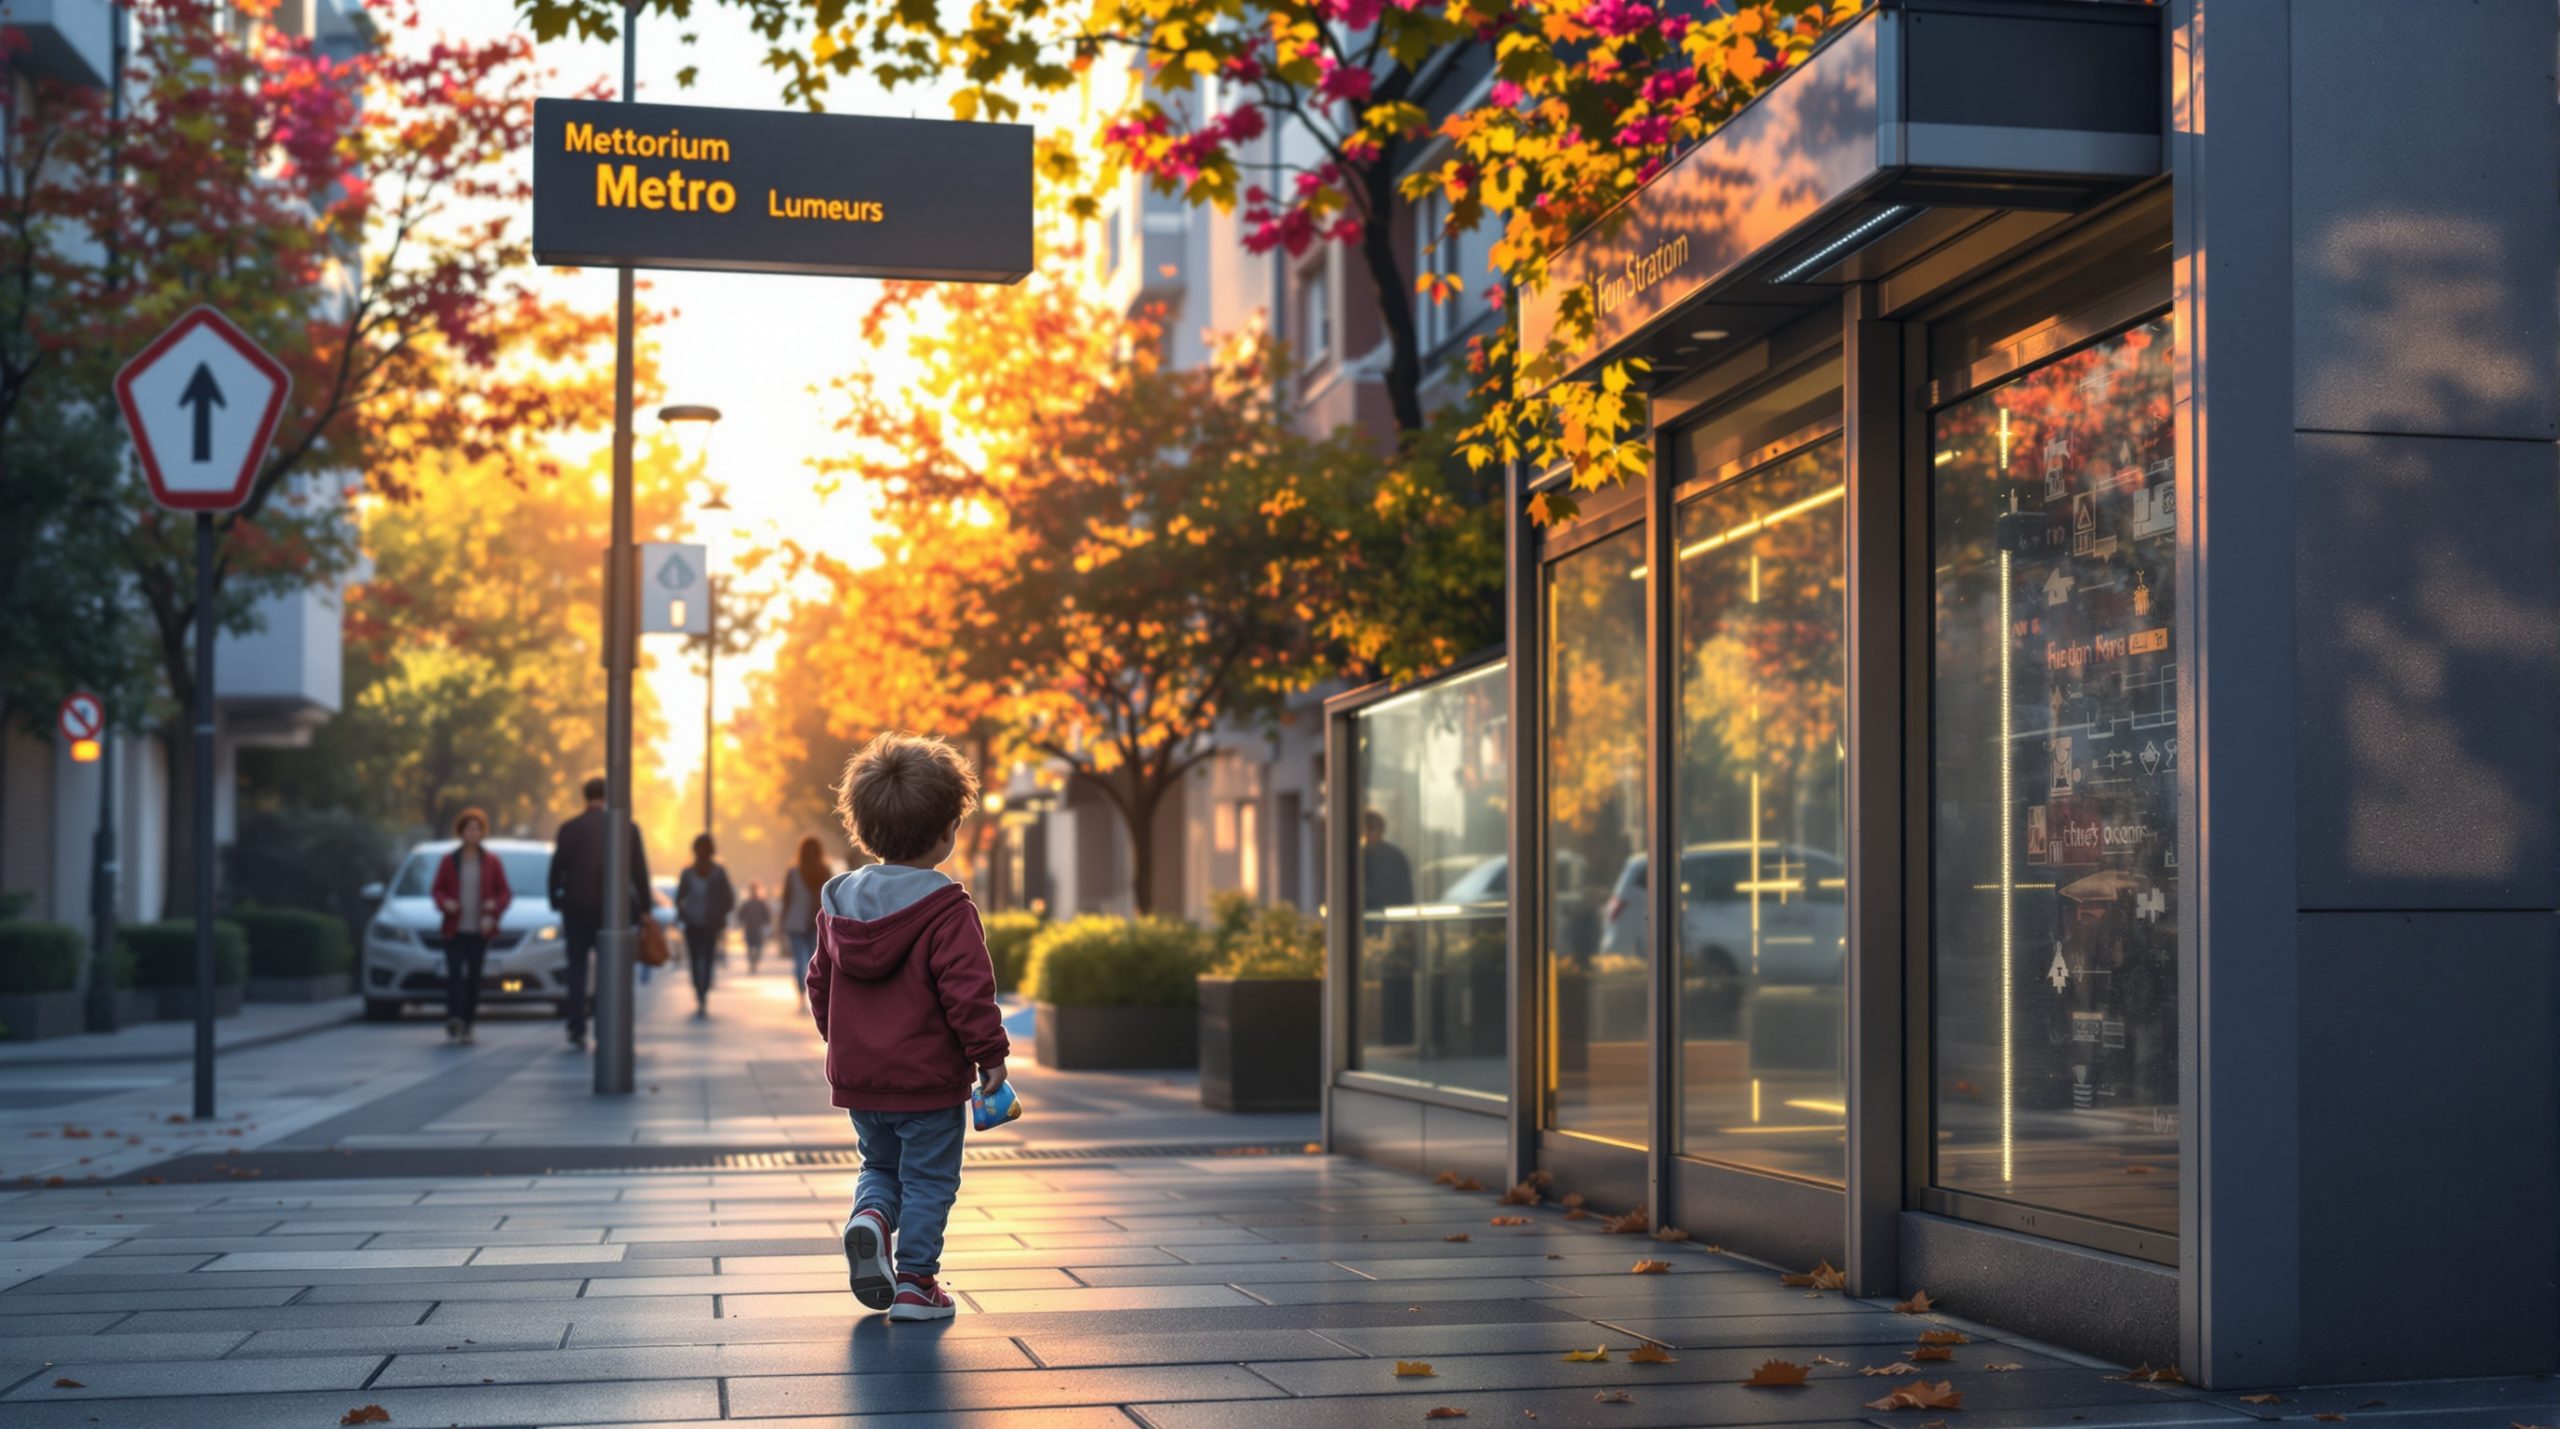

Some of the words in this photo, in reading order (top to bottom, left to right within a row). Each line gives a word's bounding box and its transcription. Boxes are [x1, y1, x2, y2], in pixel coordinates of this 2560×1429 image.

[565, 122, 730, 161] Mettorium
[596, 163, 736, 213] Metro
[769, 189, 884, 222] Lumeurs
